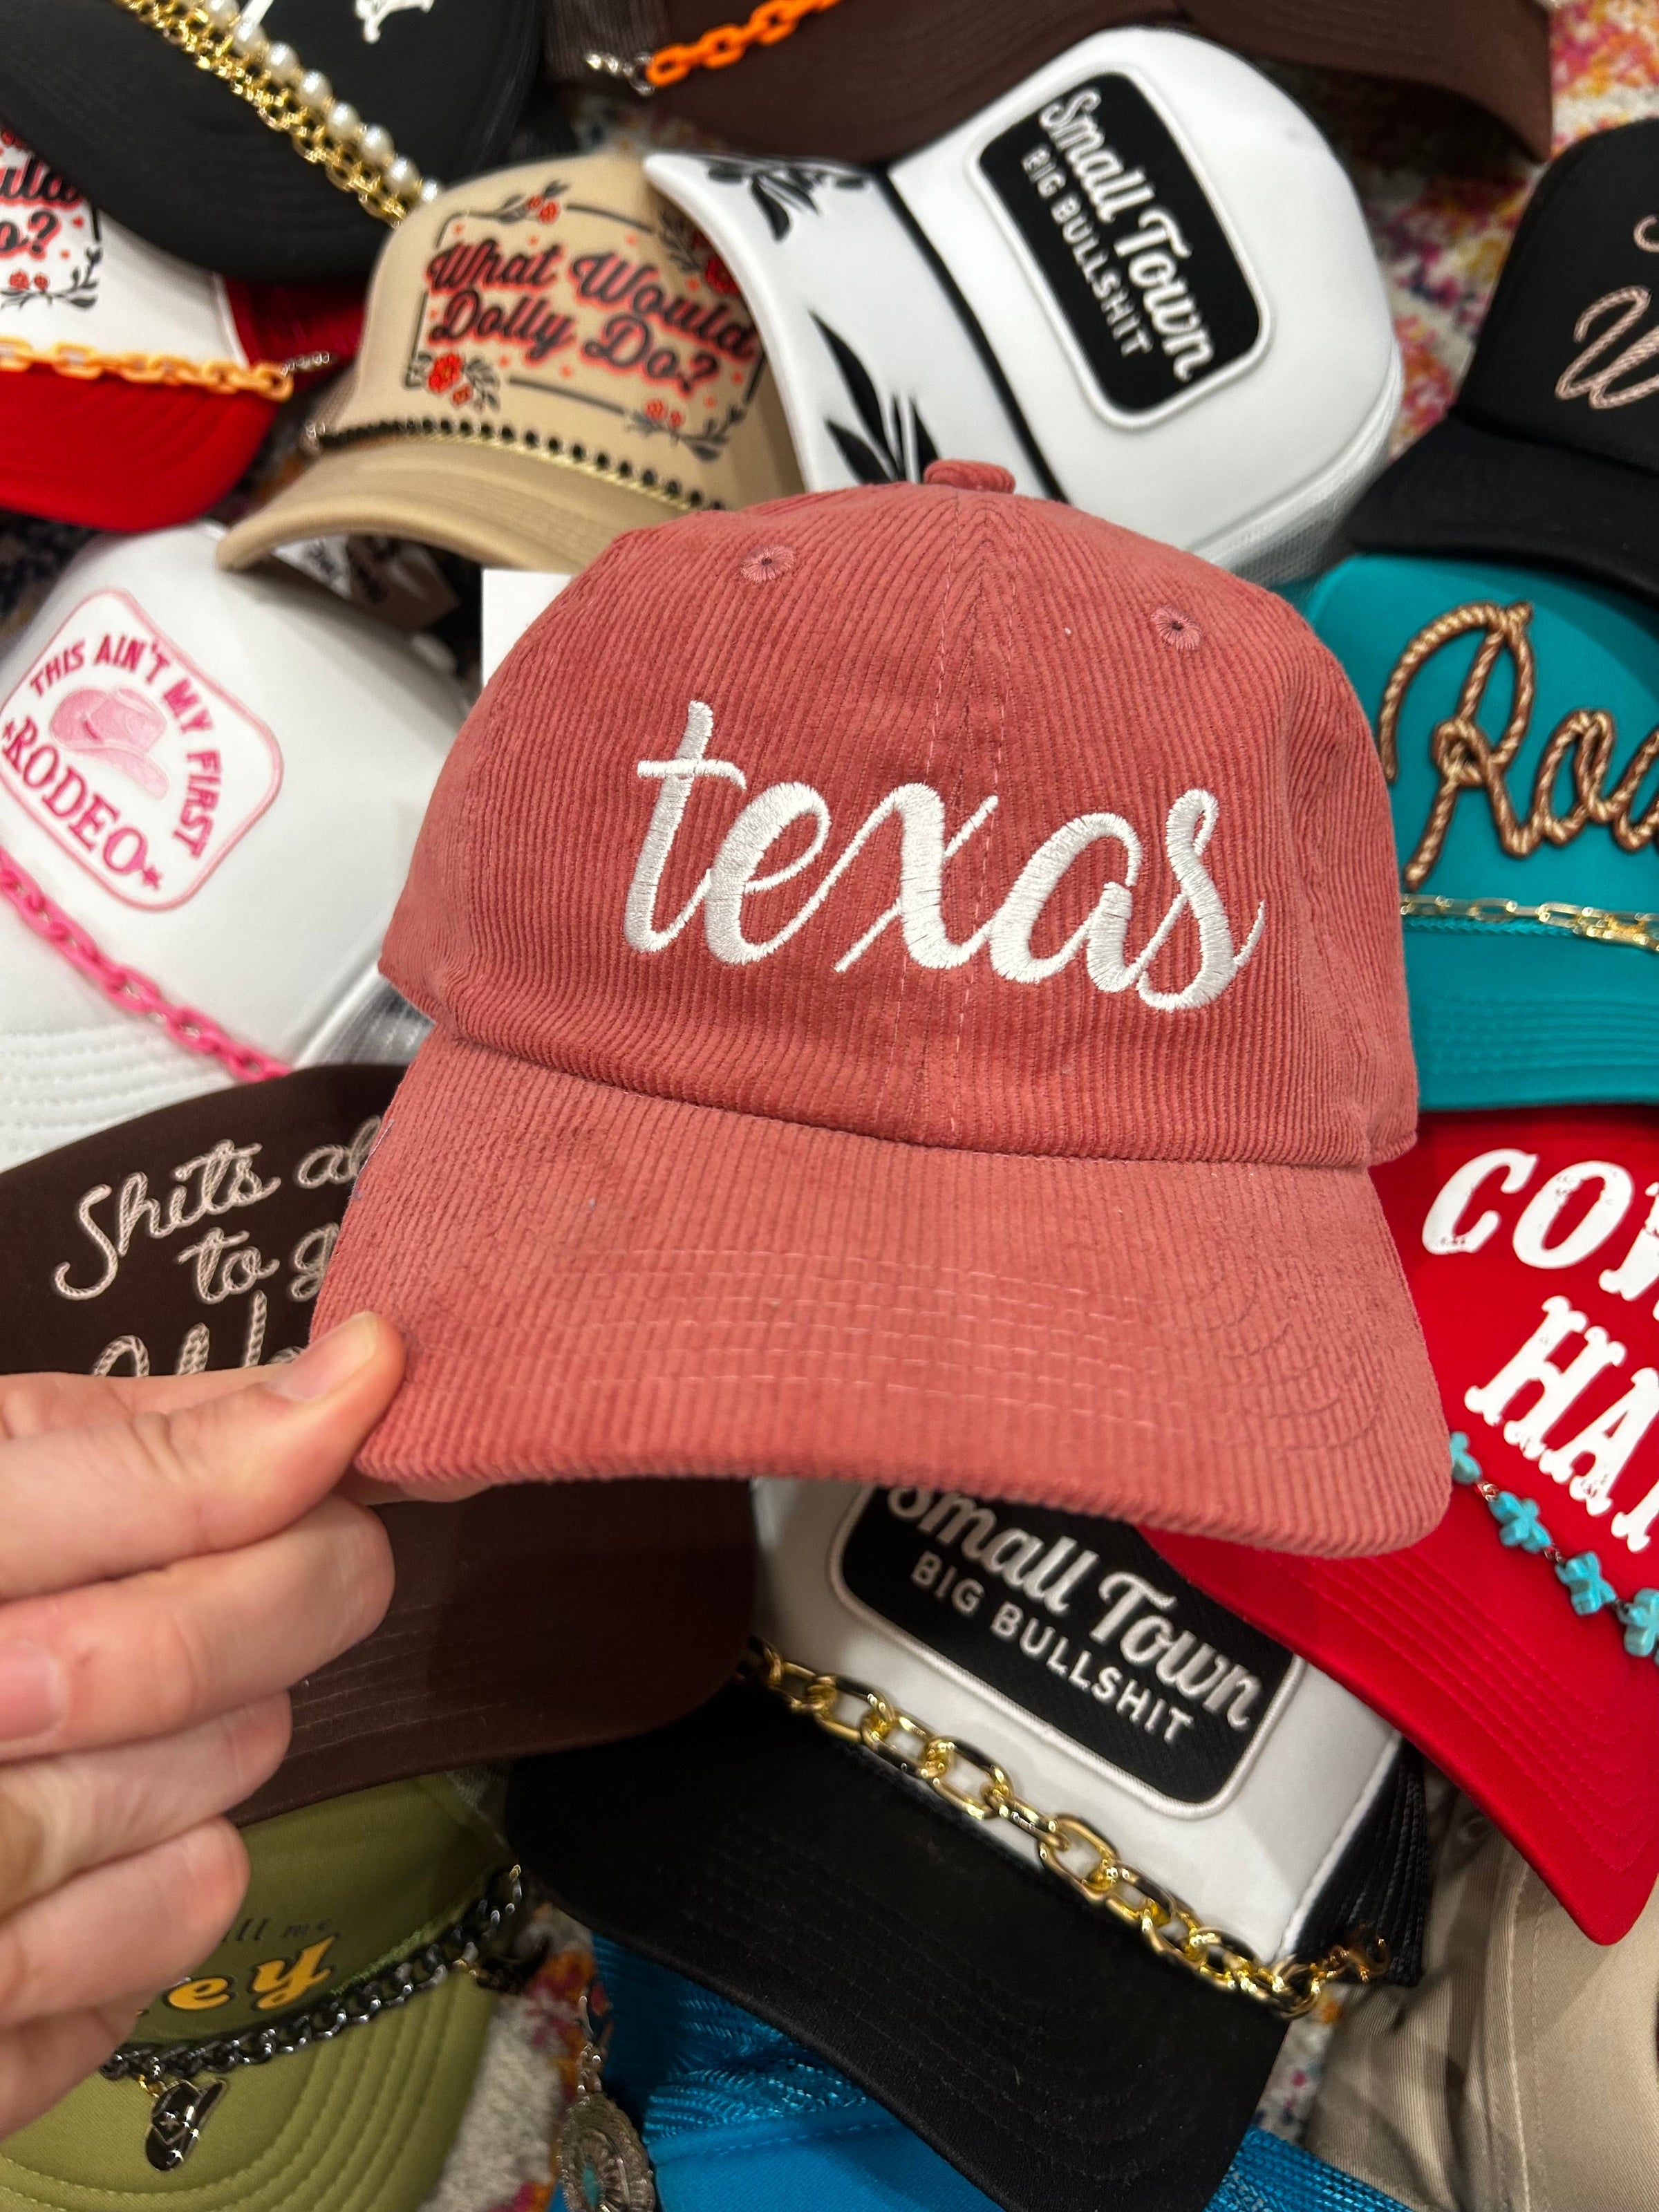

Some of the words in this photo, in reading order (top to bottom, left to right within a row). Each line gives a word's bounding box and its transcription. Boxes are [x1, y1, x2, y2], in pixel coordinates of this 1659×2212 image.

[1021, 142, 1069, 200] BIG
[1051, 189, 1153, 357] BULLSHIT
[1039, 88, 1156, 224] Small
[1113, 207, 1215, 382] Town
[426, 236, 563, 296] What
[569, 253, 758, 359] Would
[427, 289, 577, 368] Dolly
[581, 312, 722, 400] Do?
[30, 639, 86, 697] THIS
[92, 634, 171, 685] AIN'T
[162, 677, 215, 734] MY
[2, 715, 149, 877] RODEO
[171, 749, 223, 859] FIRST
[624, 700, 1266, 1013] texas
[53, 1139, 282, 1300] Shits
[176, 1226, 281, 1303] to
[910, 1550, 985, 1618] BIG
[990, 1602, 1195, 1743] BULLSHIT
[1098, 1571, 1264, 1728] Town
[134, 1934, 339, 2013] ey
